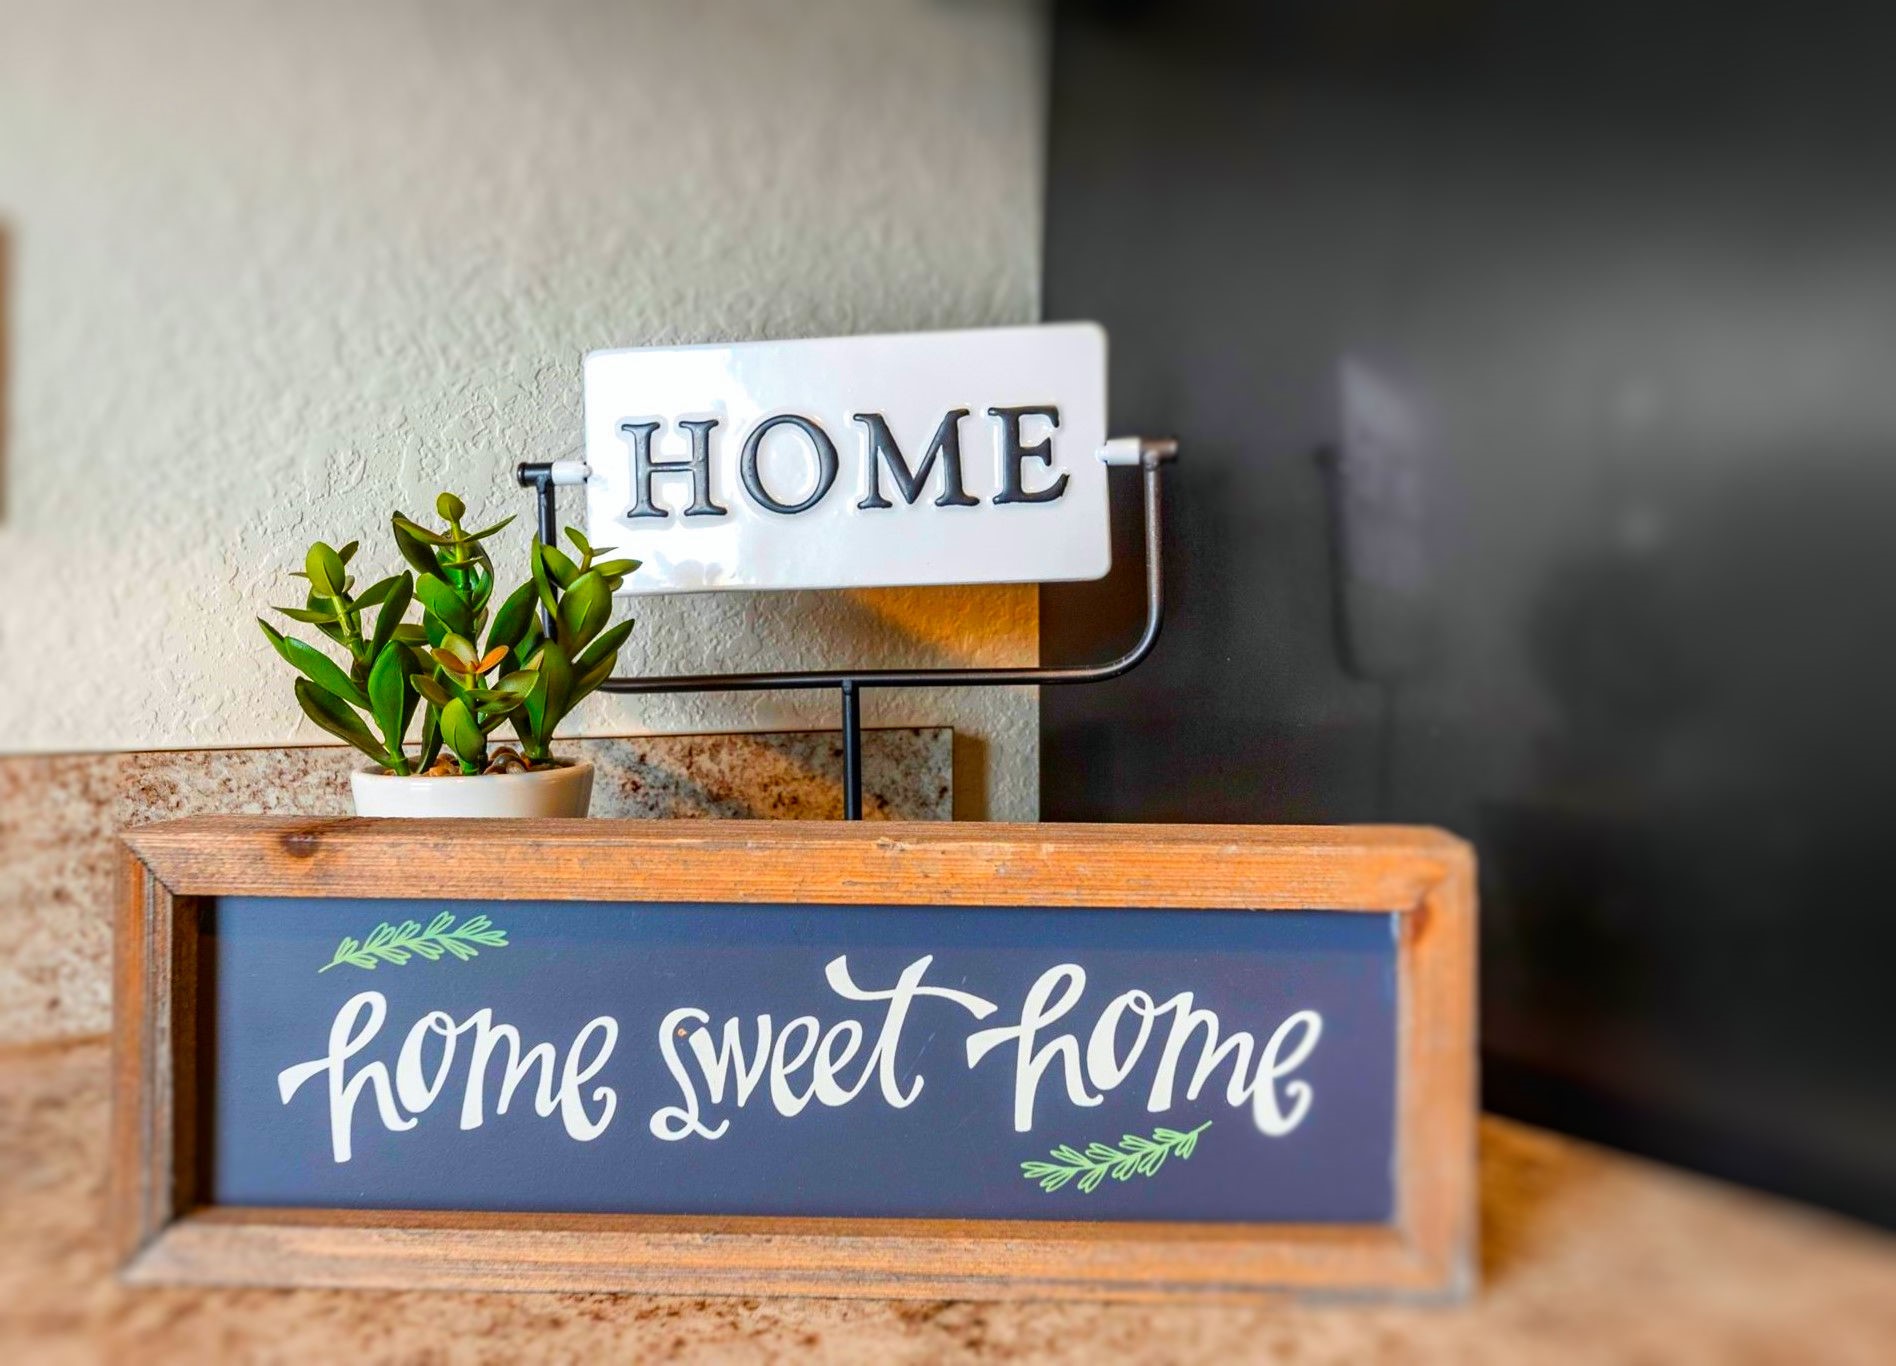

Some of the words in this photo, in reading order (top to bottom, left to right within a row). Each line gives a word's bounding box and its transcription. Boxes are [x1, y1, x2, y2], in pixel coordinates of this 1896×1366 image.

[620, 404, 1072, 519] HOME
[278, 990, 619, 1164] home
[649, 954, 999, 1142] sweet
[966, 963, 1324, 1138] home
